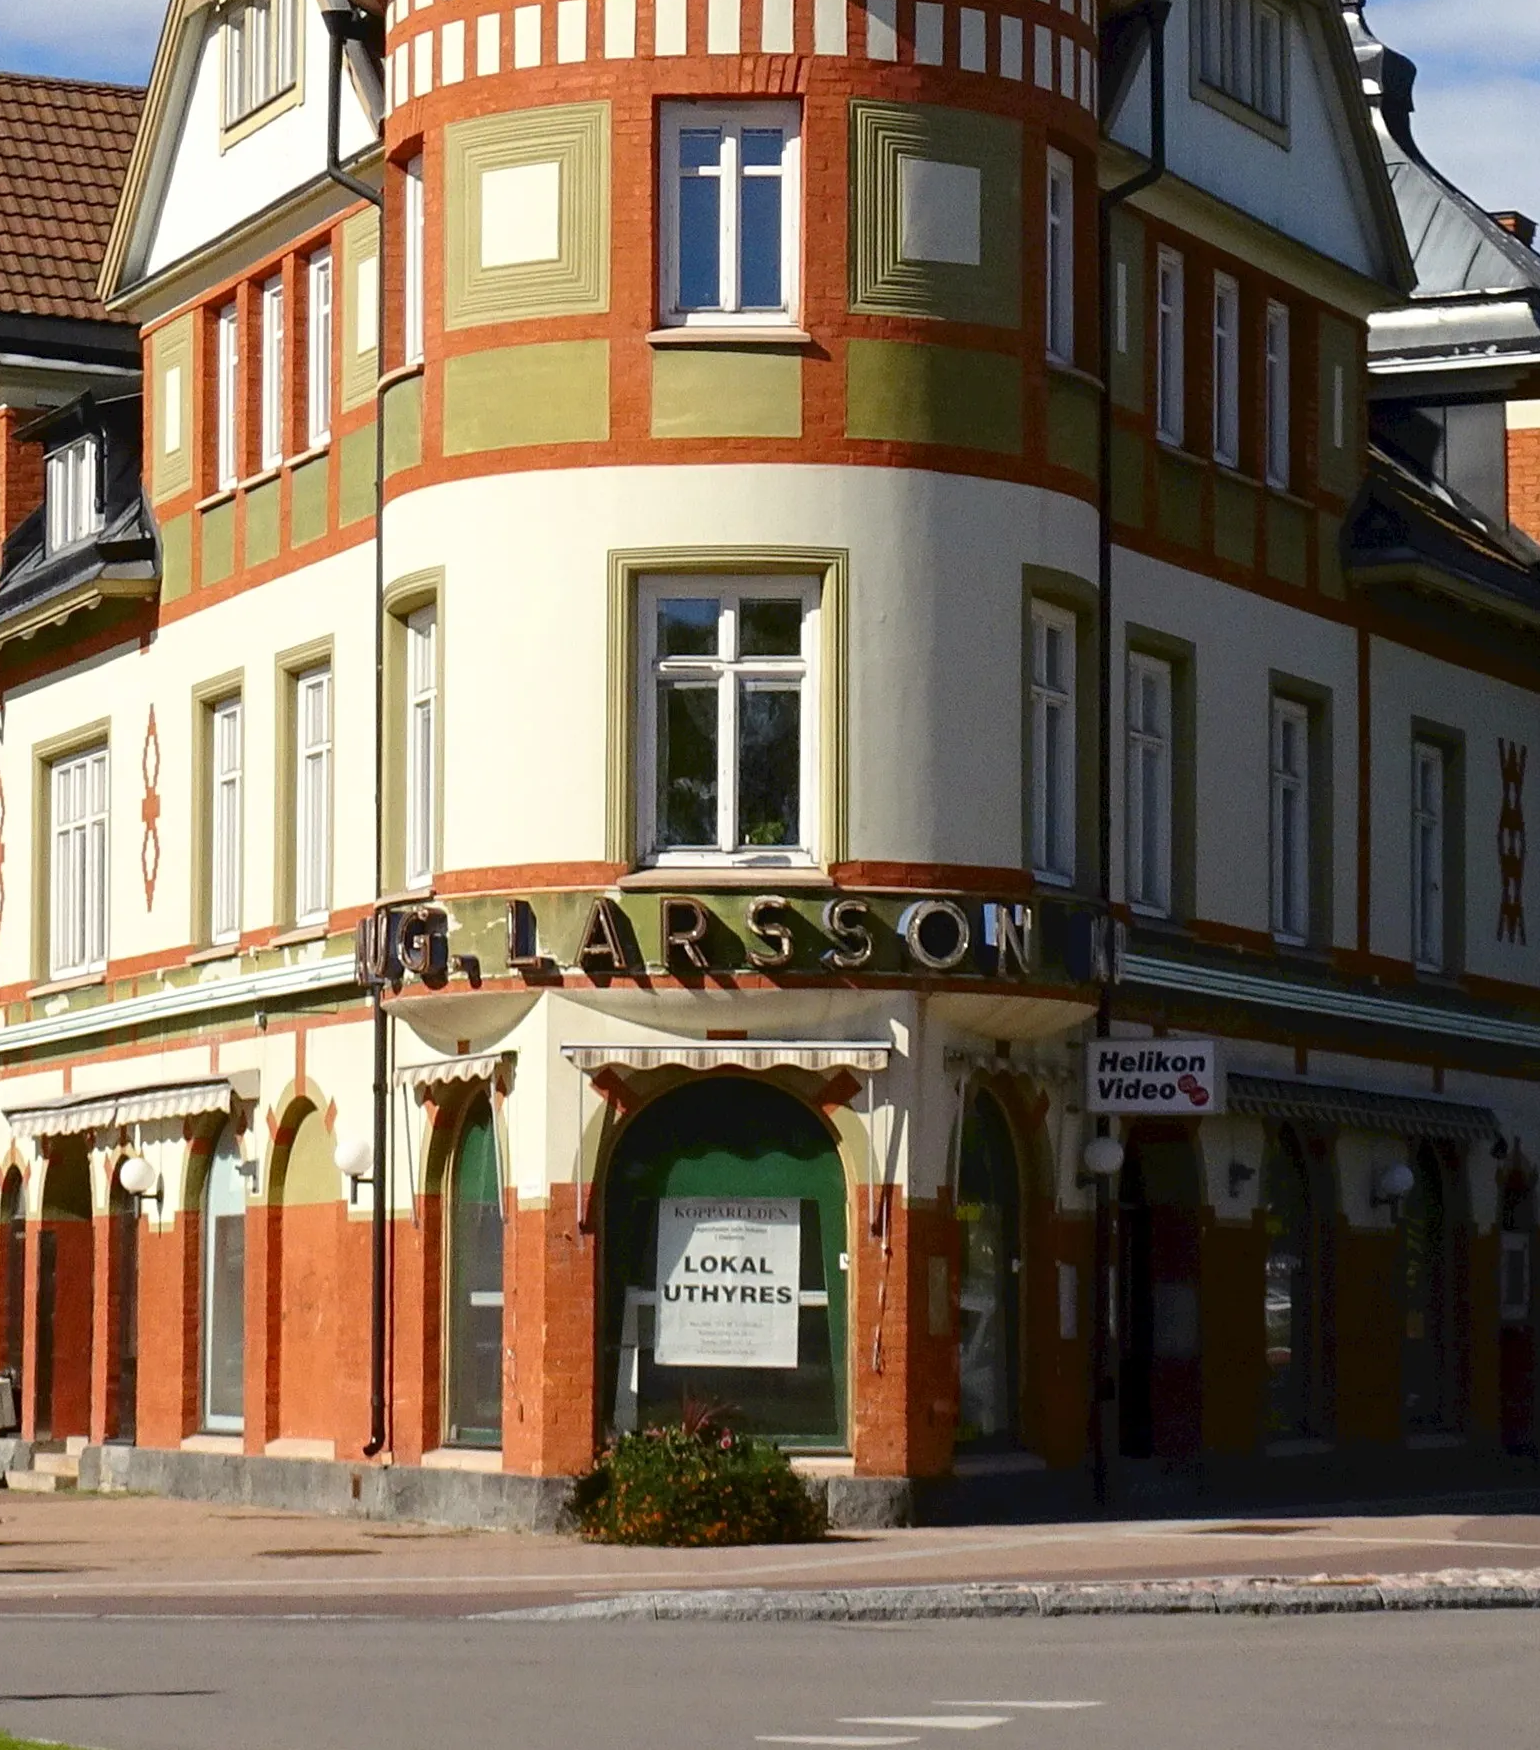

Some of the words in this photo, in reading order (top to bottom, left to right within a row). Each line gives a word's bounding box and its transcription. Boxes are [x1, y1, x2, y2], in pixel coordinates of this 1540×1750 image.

[505, 895, 1033, 979] LARSSON
[1097, 1050, 1206, 1073] Helikon
[1097, 1077, 1177, 1101] Video
[674, 1206, 788, 1220] KOPPARLEDEN
[683, 1255, 774, 1275] LOKAL
[663, 1283, 793, 1305] UTHYRES
